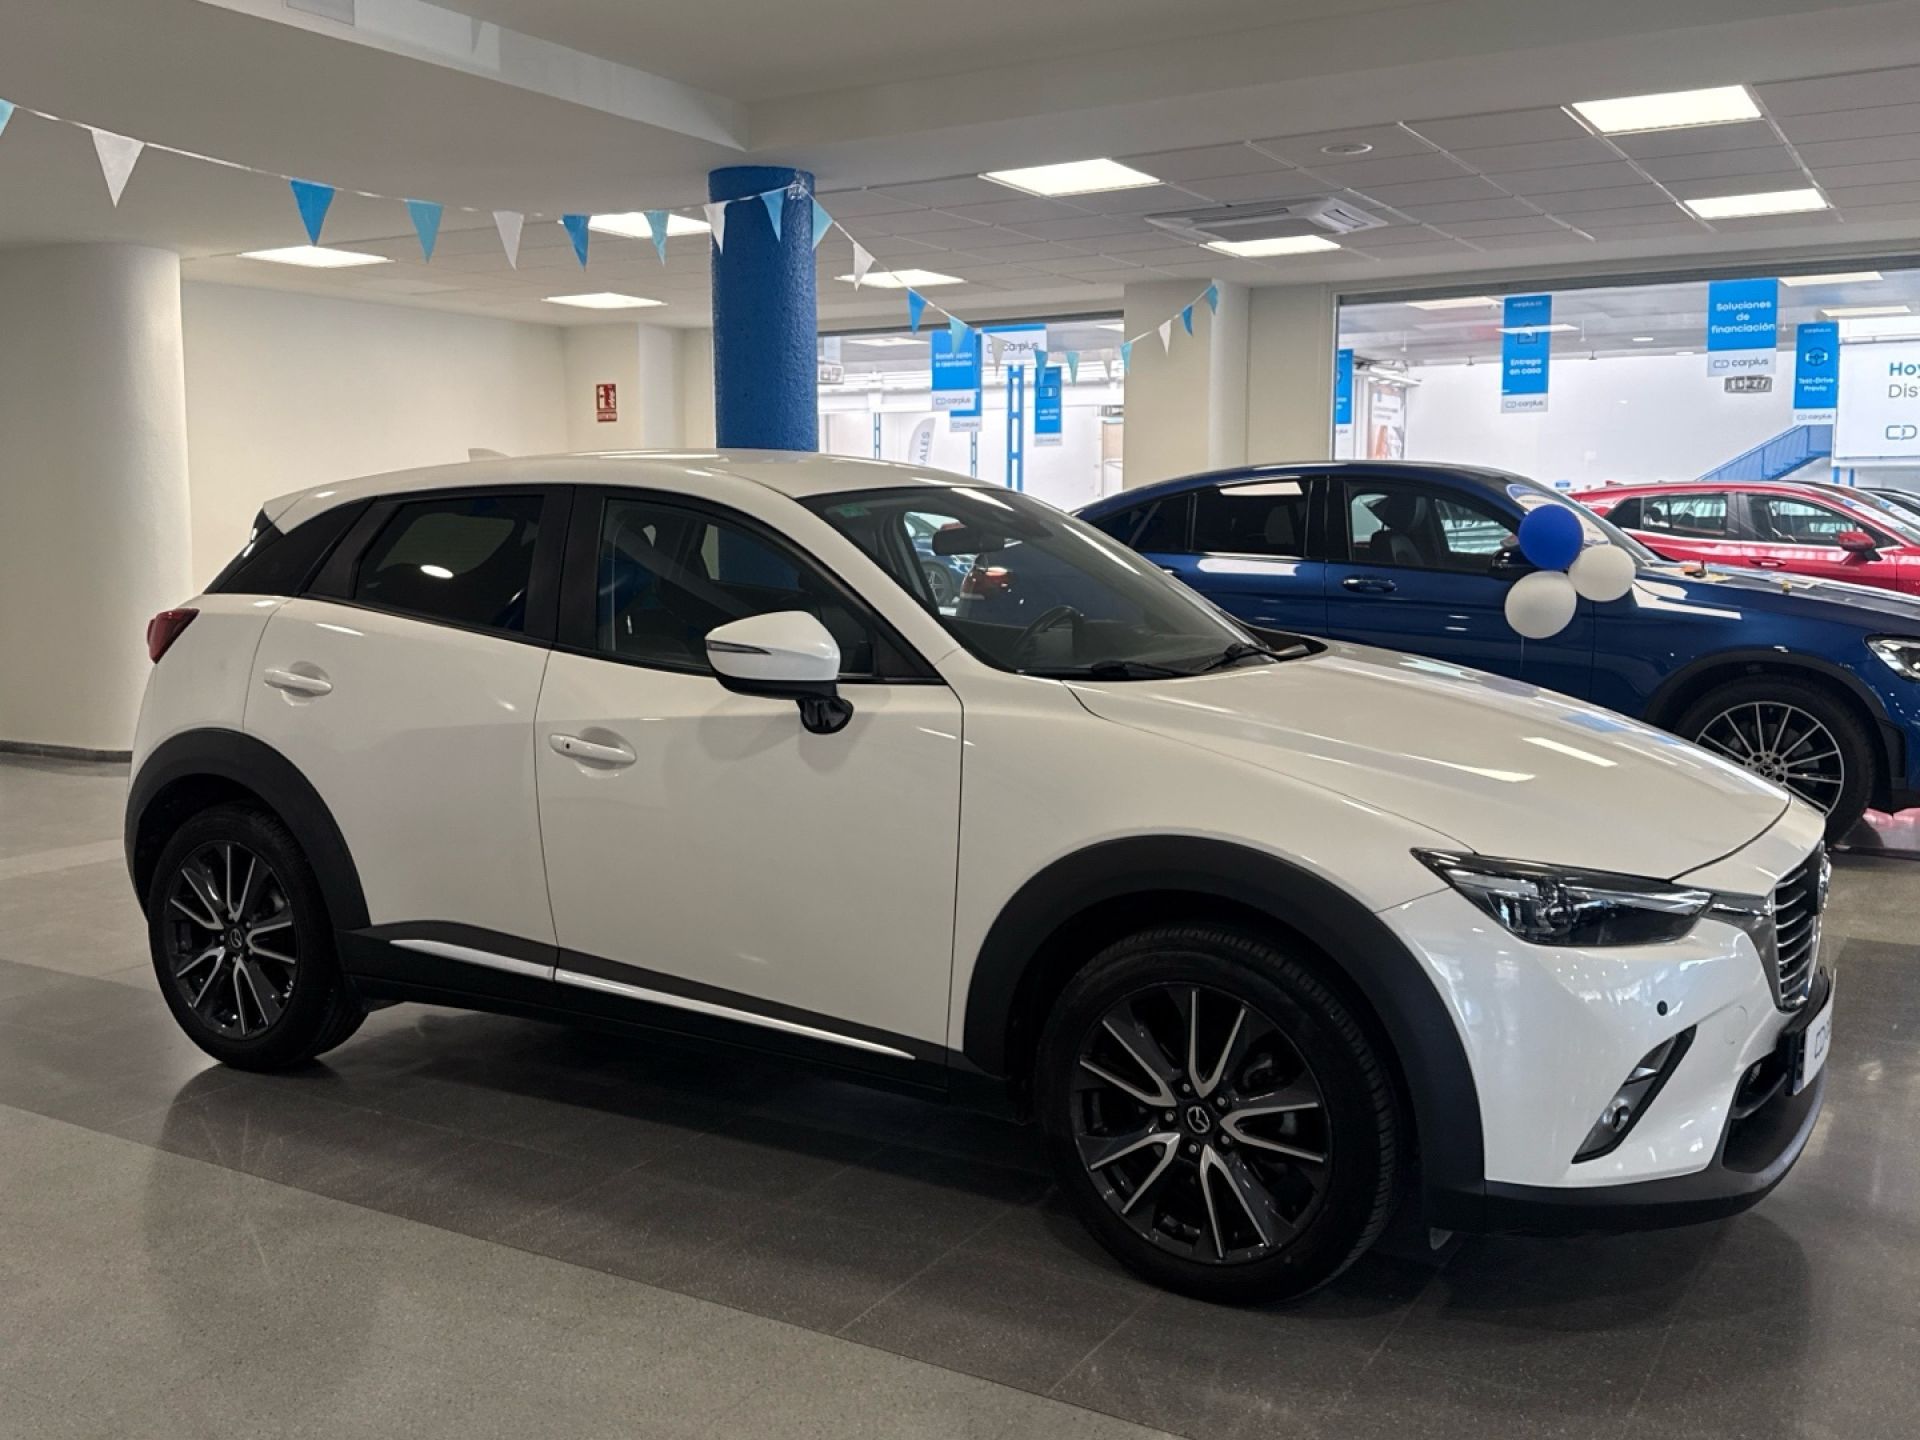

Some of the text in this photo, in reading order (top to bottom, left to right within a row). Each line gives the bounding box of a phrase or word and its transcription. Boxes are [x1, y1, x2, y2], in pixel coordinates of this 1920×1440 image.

[1716, 301, 1772, 311] Soluciones
[1736, 312, 1750, 321] de
[1711, 322, 1776, 334] financiación
[1003, 341, 1038, 354] carplus
[1510, 358, 1542, 367] Entrega
[1731, 357, 1769, 369] carplus
[1521, 367, 1542, 375] casa
[1888, 383, 1920, 398] Dis
